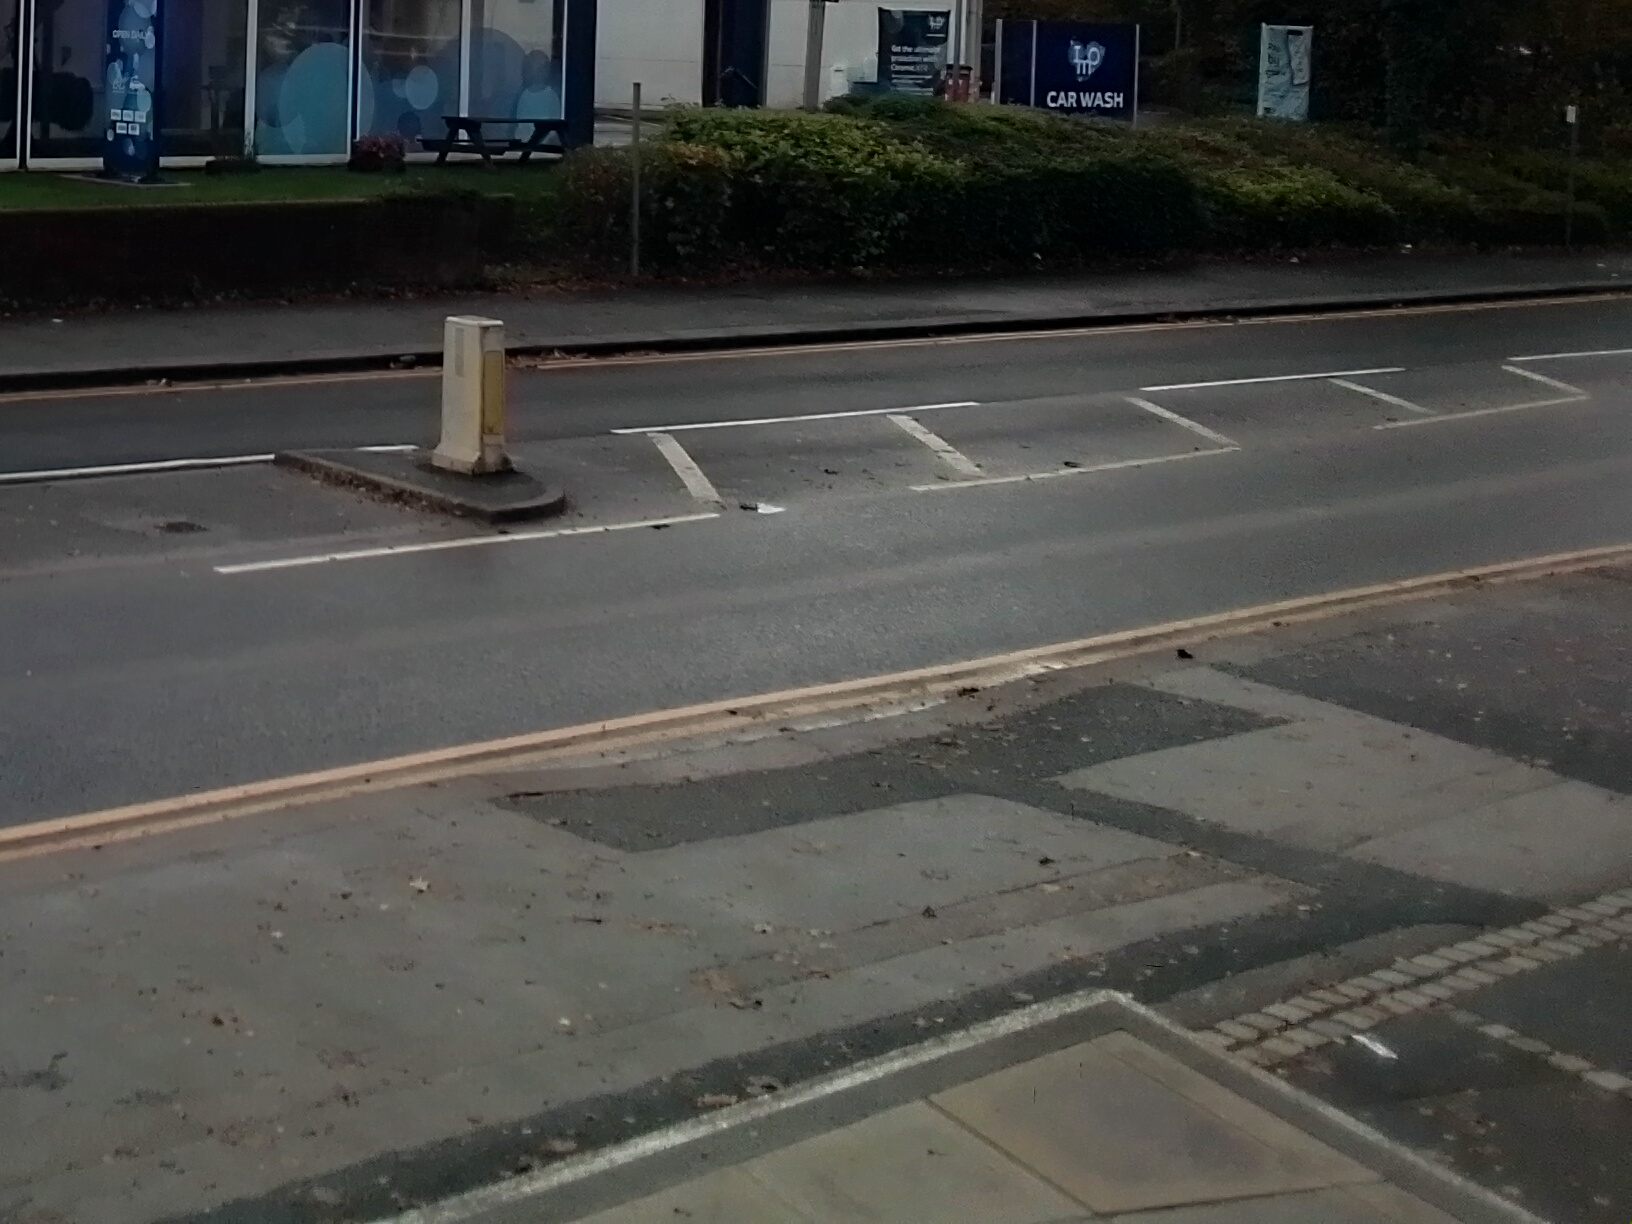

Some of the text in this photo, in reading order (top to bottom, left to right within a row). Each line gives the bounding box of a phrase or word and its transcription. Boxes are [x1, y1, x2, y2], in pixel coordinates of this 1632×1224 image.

[112, 29, 130, 39] OPEN
[1046, 90, 1124, 109] CAR WASH
